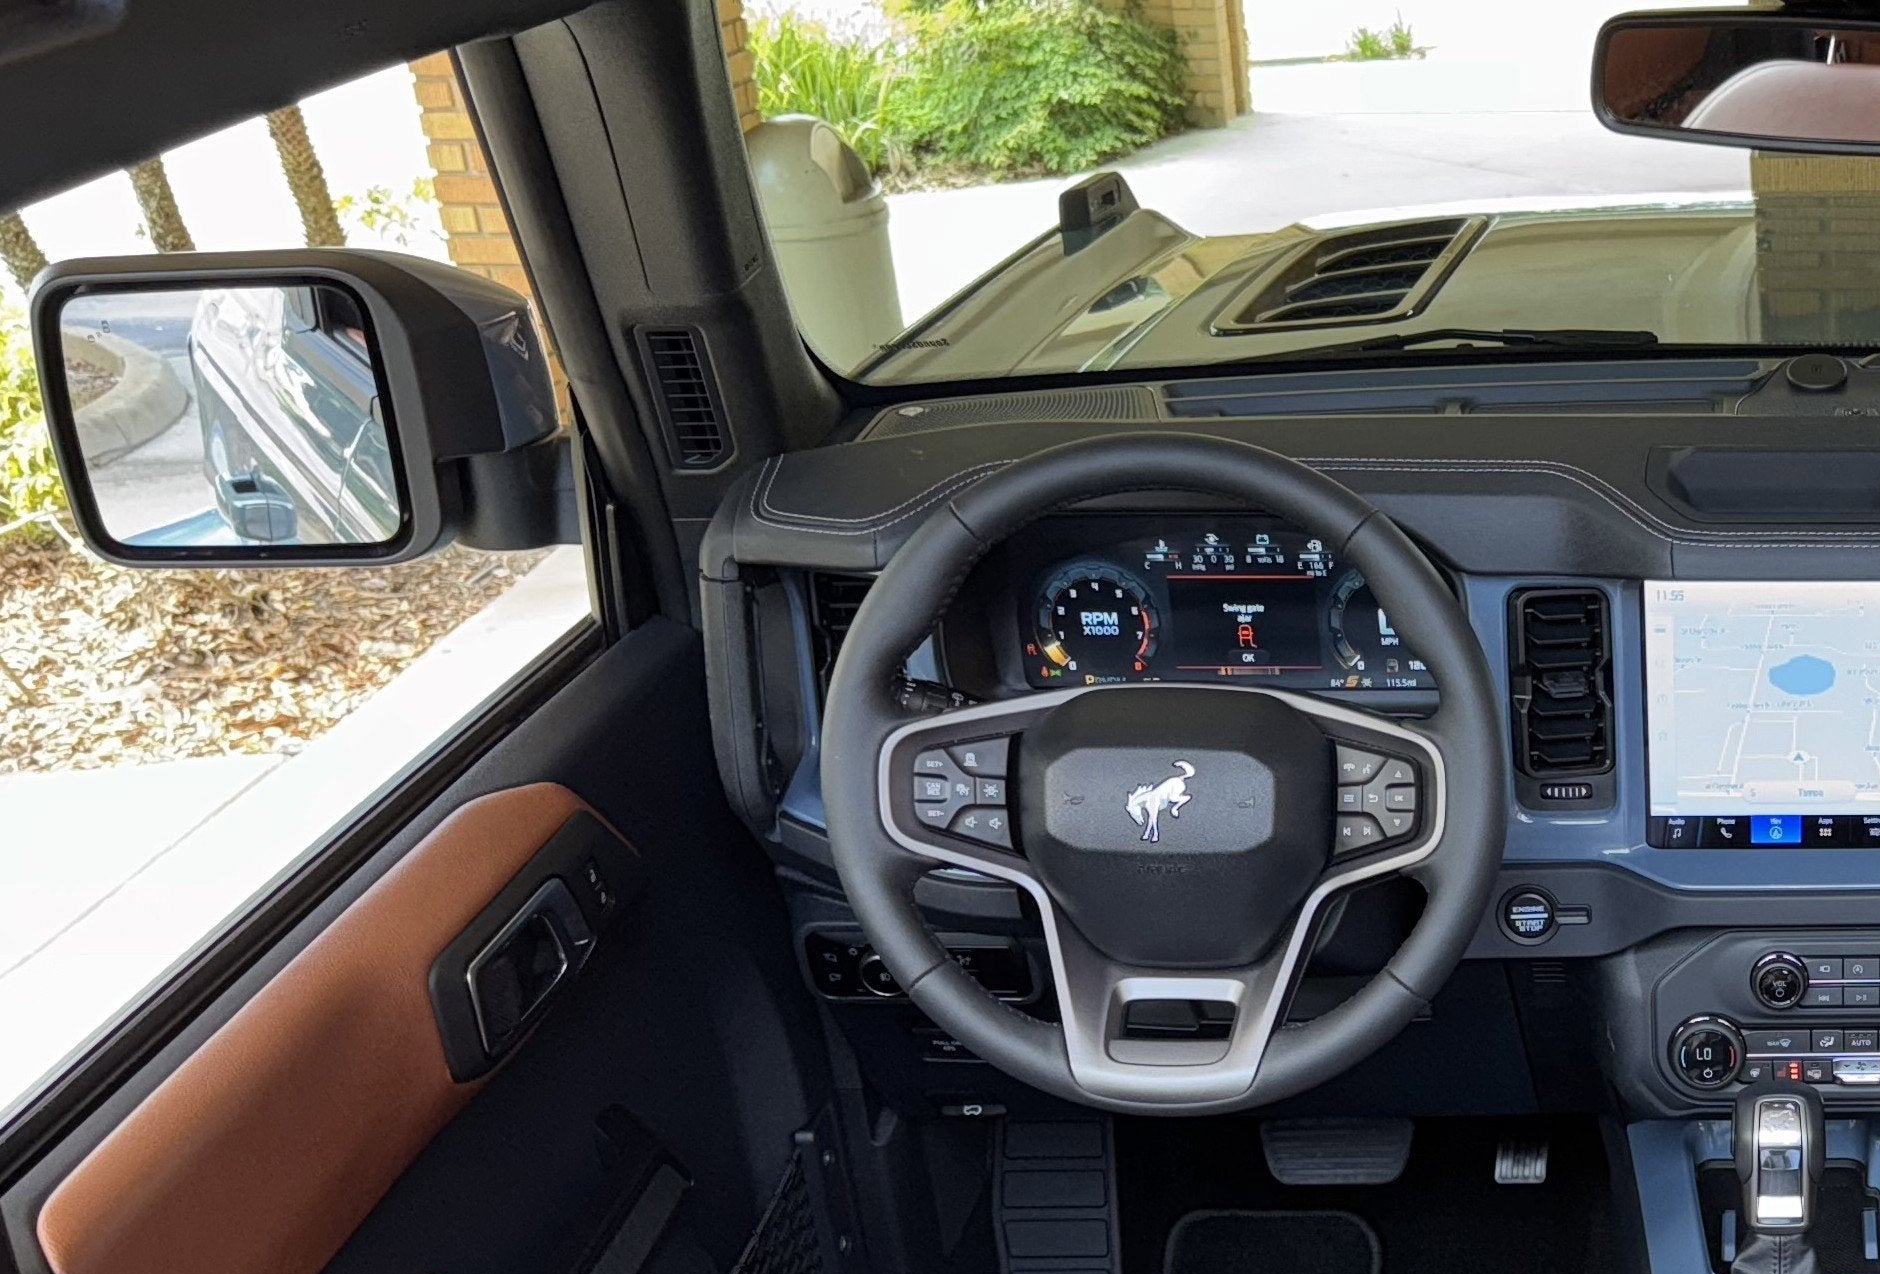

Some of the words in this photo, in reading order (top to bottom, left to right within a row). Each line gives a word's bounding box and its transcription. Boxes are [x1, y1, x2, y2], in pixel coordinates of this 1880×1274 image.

[1080, 611, 1119, 625] RPM
[1851, 1038, 1871, 1046] AUTO
[1696, 1048, 1712, 1061] LO
